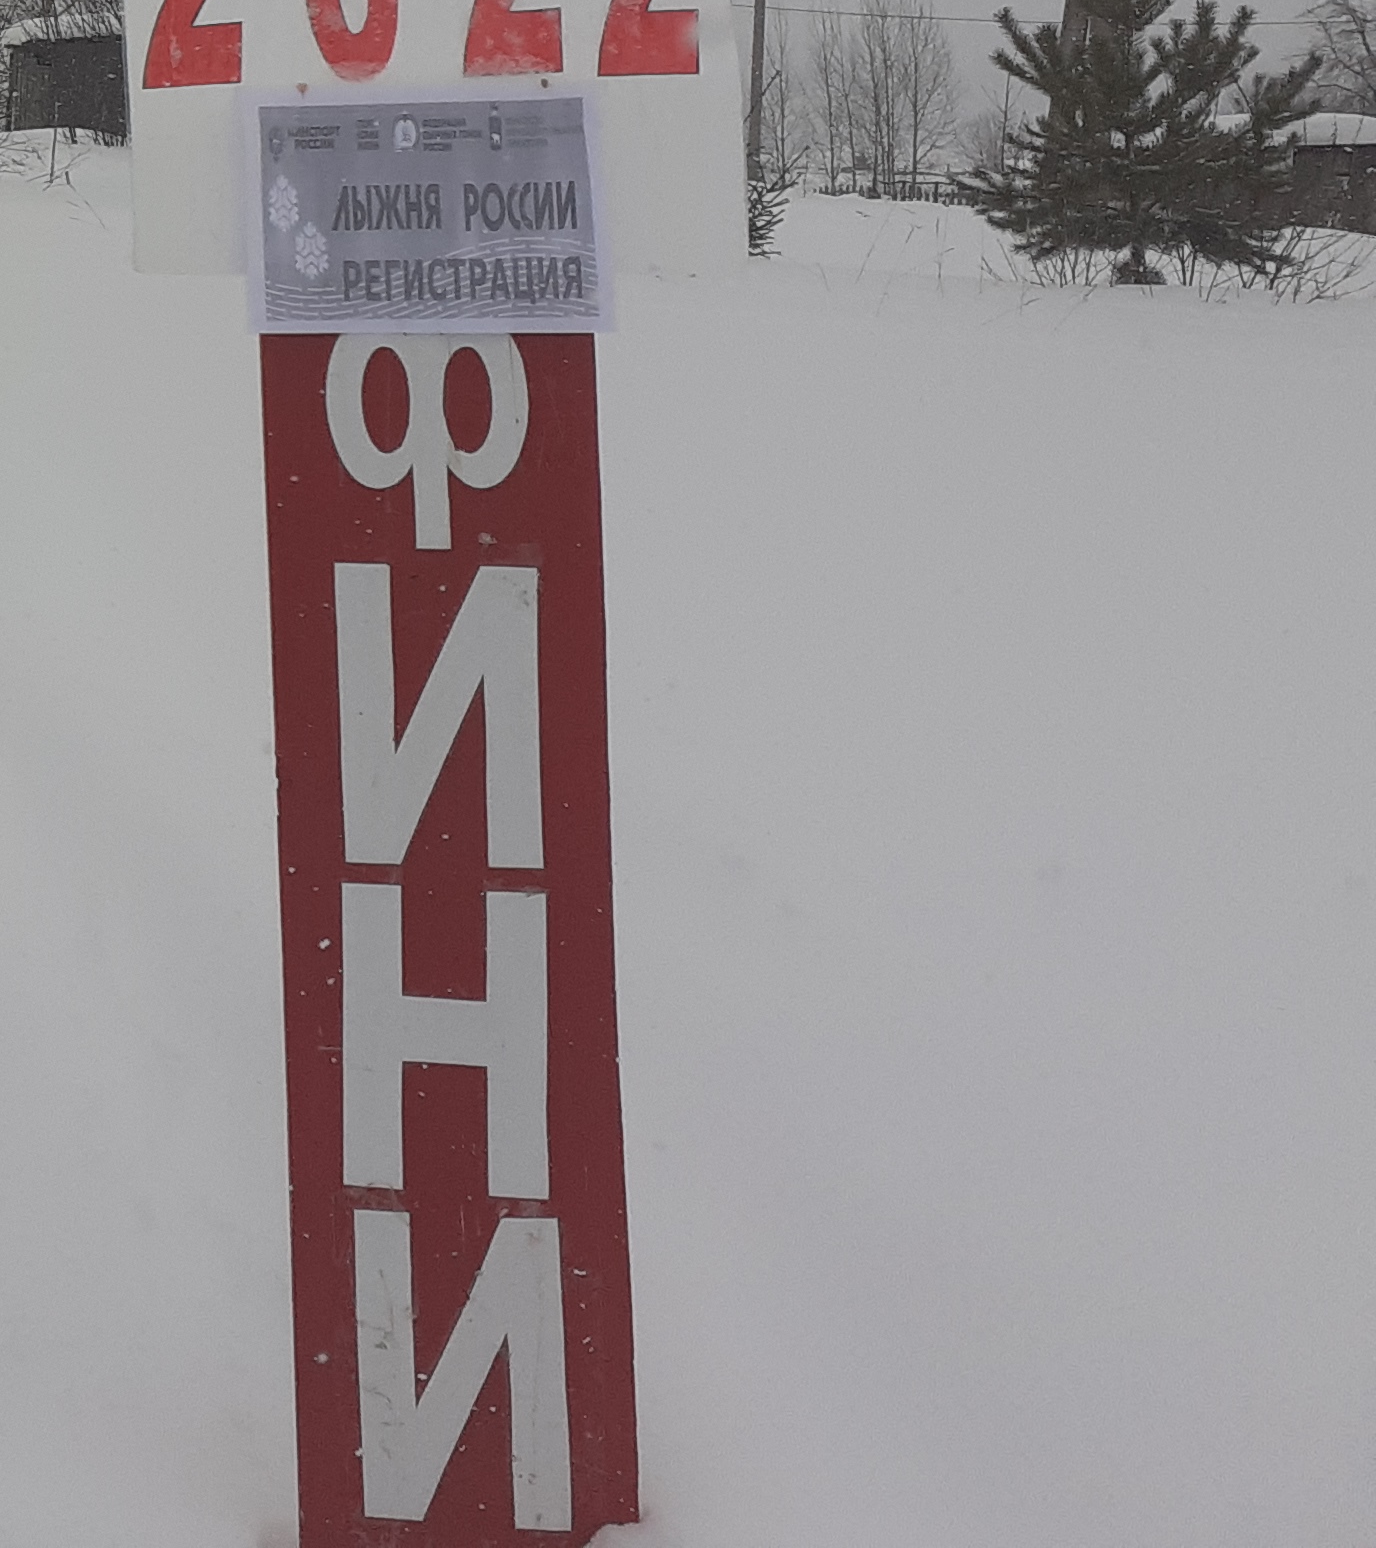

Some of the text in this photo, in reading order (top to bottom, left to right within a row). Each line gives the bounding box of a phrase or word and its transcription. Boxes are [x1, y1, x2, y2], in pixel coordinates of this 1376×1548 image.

[331, 180, 579, 232] ЛЫЖНЯ РОССИИ
[342, 255, 584, 305] РЕГИСТРАЦИЯ
